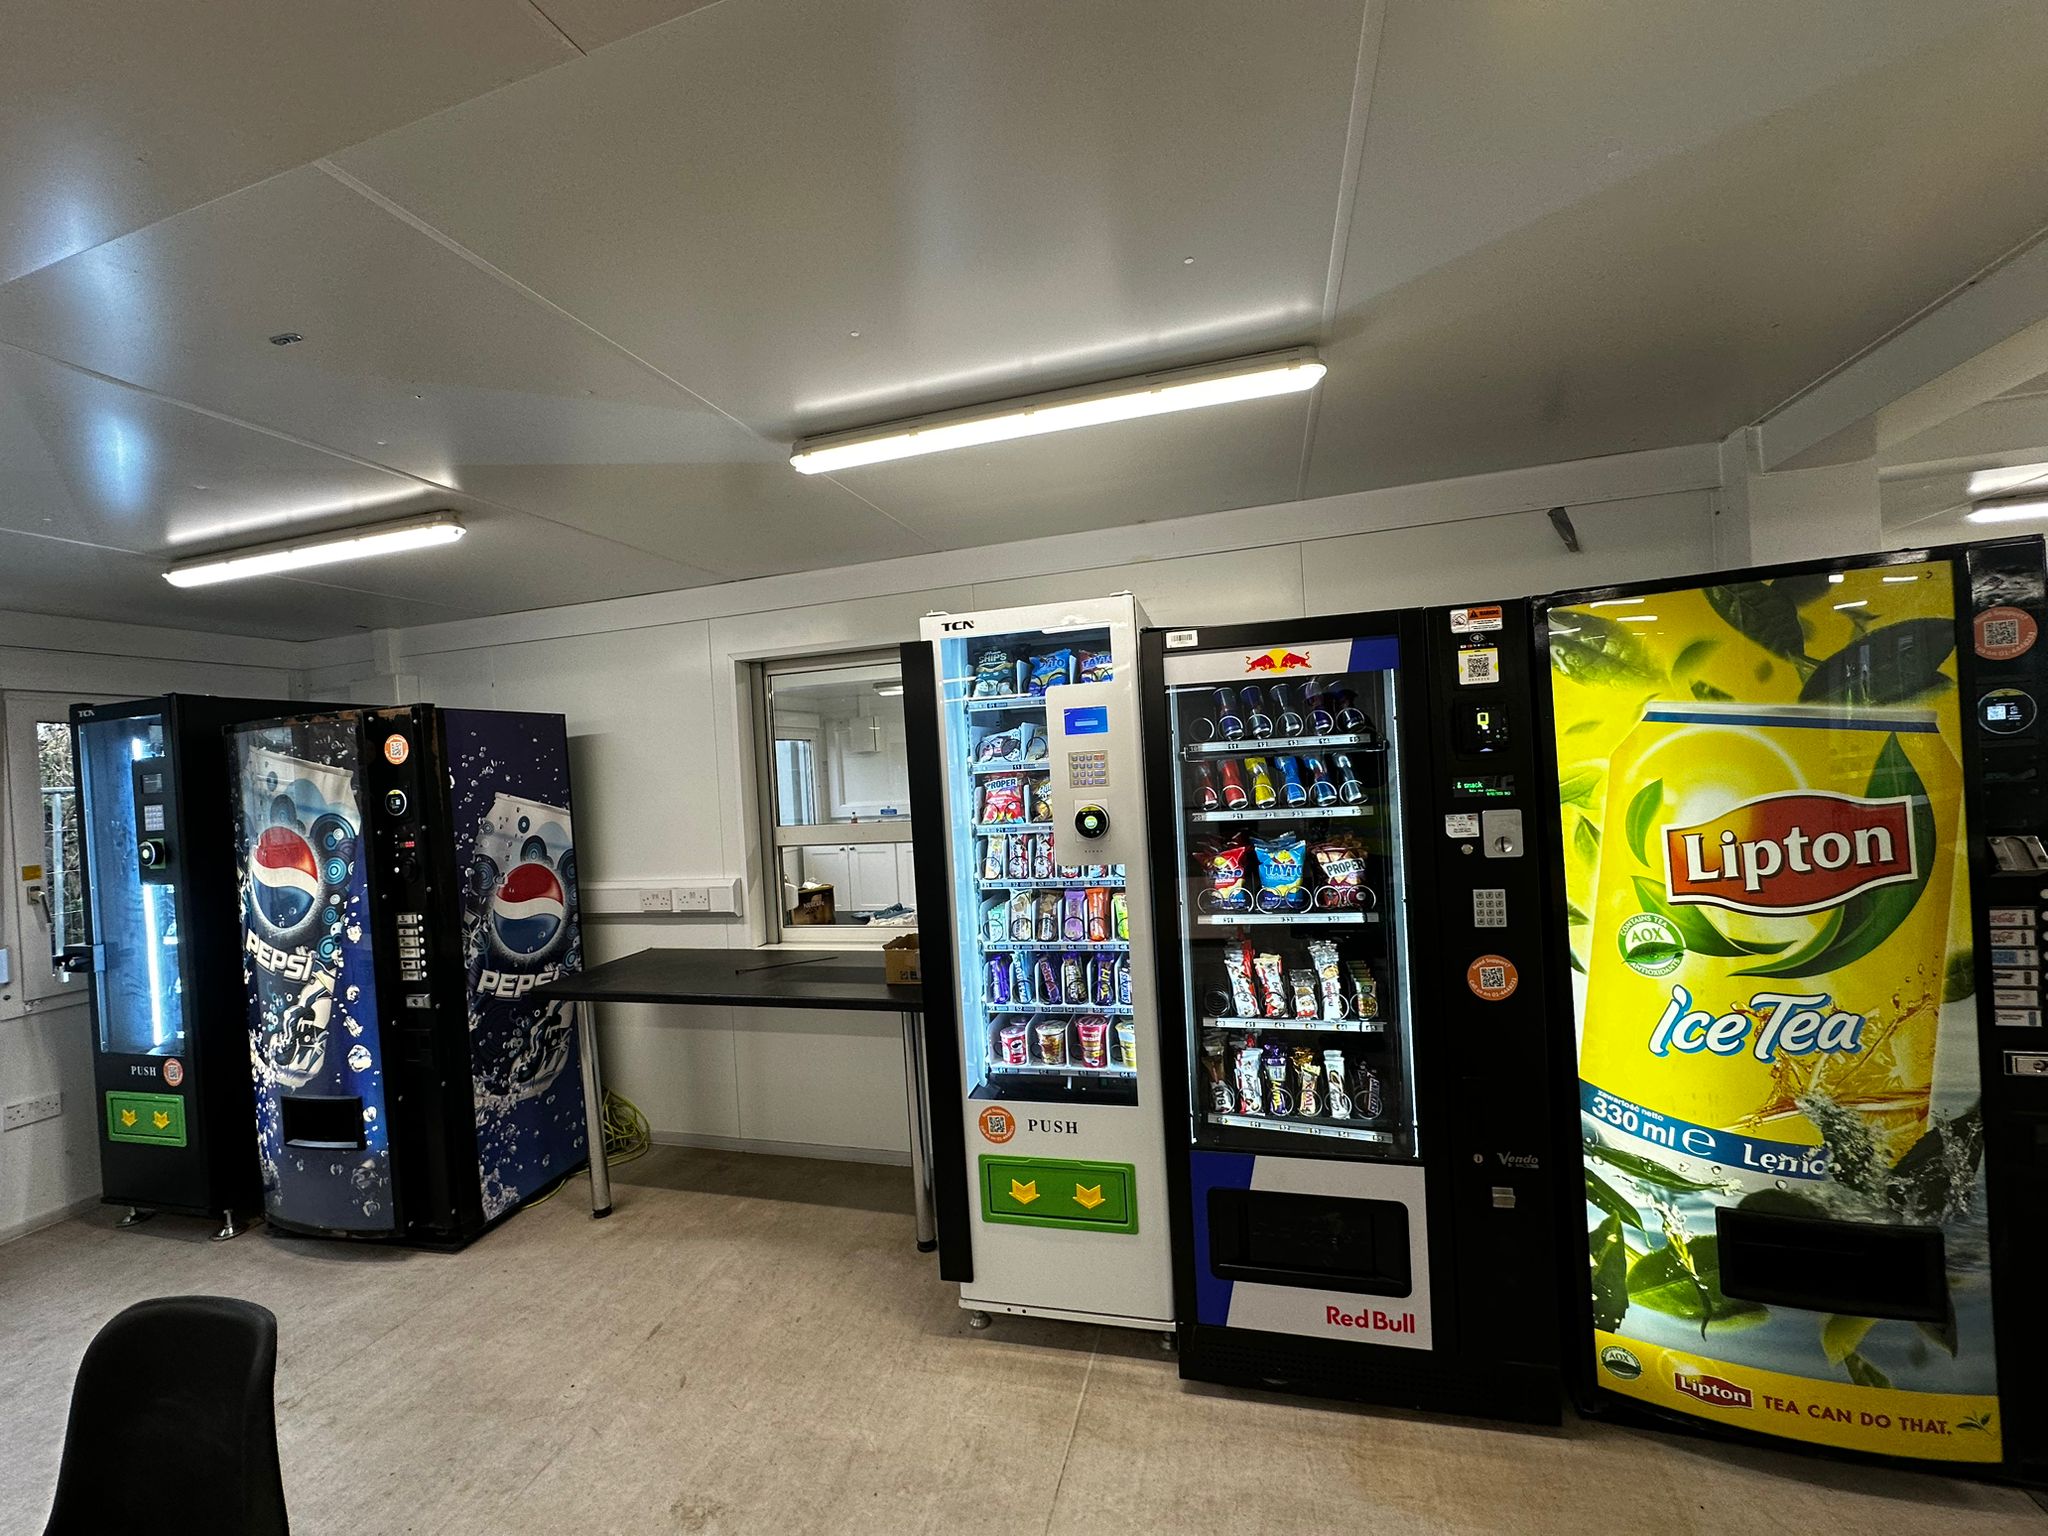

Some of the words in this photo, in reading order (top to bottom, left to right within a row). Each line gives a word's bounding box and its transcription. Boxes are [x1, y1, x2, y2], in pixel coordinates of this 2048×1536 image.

[941, 620, 974, 632] TCN
[1326, 860, 1366, 876] PROPER
[1682, 825, 1895, 892] Lipton
[1620, 915, 1652, 937] CONTAINS
[1654, 916, 1668, 928] TEA
[1631, 927, 1664, 943] AOX
[245, 928, 313, 982] PEPSI
[1750, 992, 1865, 1063] Tea
[130, 1066, 157, 1076] PUSH
[1597, 1090, 1640, 1113] zawartość
[1641, 1109, 1664, 1122] netto
[1027, 1118, 1078, 1134] PUSH
[1591, 1096, 1639, 1132] 330
[1642, 1121, 1676, 1147] ml
[1496, 1151, 1539, 1166] Vendo
[1743, 1142, 1826, 1175] Lemo
[1326, 1306, 1369, 1328] Red
[1372, 1311, 1415, 1334] Bull
[1609, 1352, 1630, 1363] AOX
[1680, 1376, 1746, 1403] Lipton
[1762, 1395, 1800, 1415] TEA
[1807, 1404, 1852, 1424] CAN
[1861, 1412, 1892, 1429] DO
[1898, 1416, 1953, 1435] THAT.
